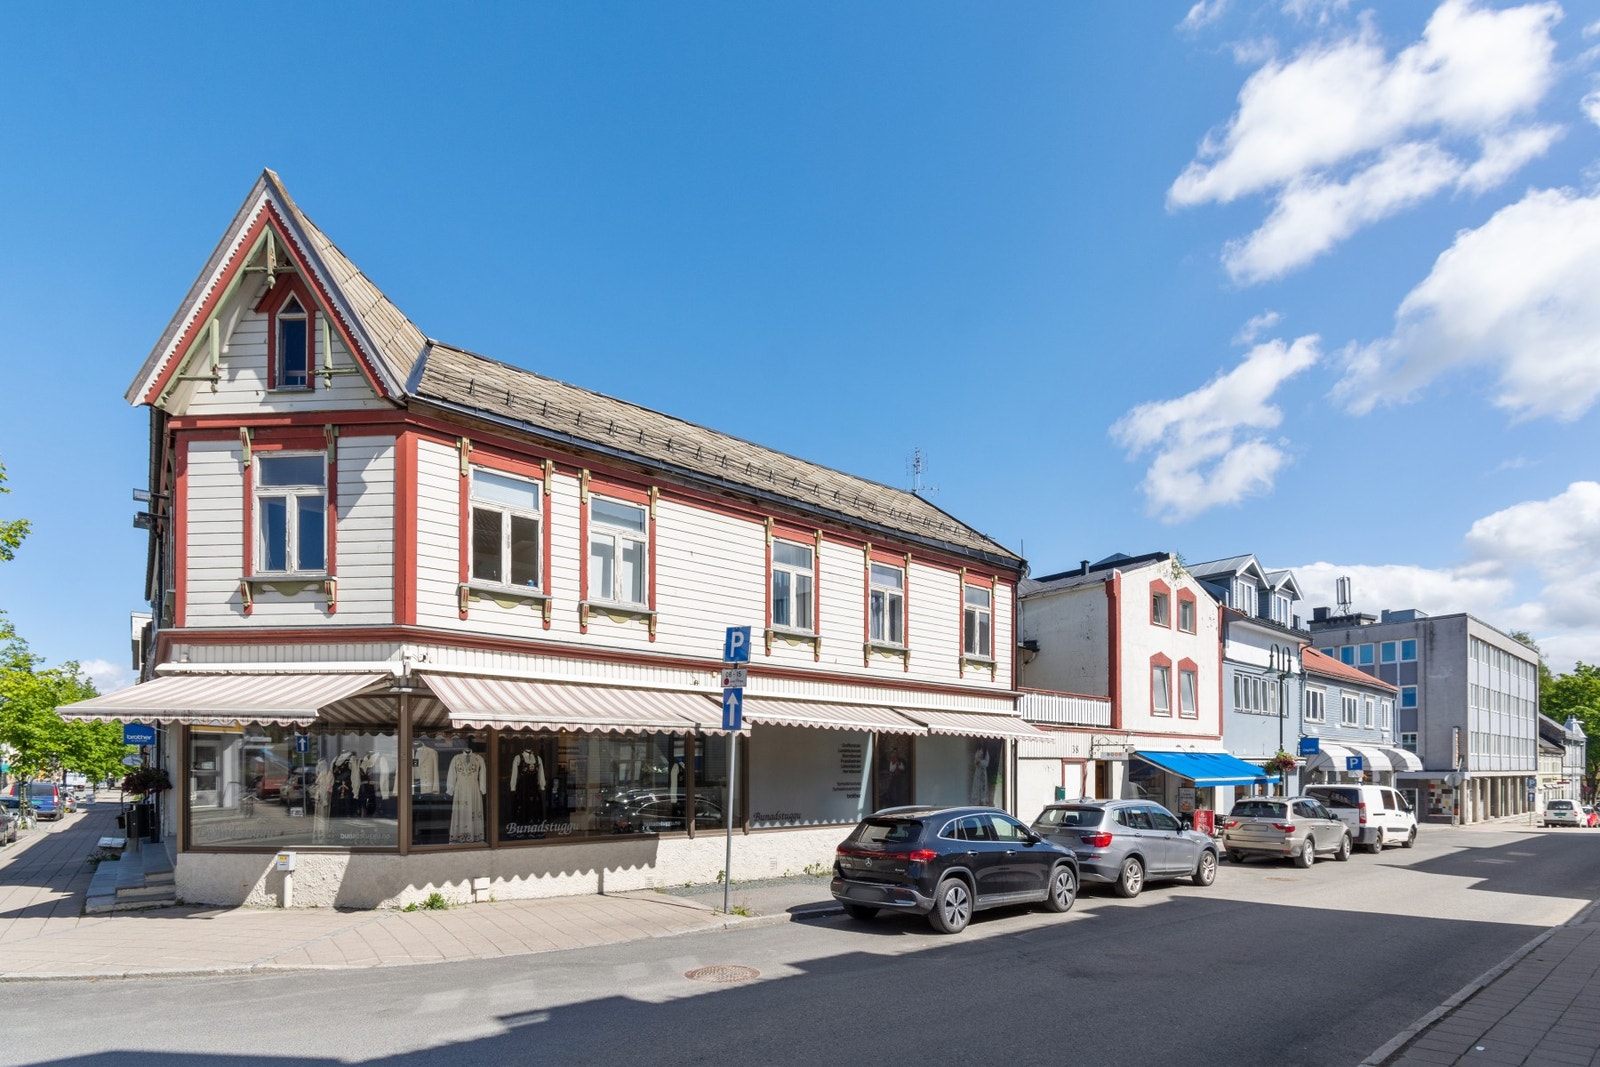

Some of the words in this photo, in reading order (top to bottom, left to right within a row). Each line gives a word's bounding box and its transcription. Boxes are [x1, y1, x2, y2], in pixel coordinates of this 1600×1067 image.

[730, 631, 745, 657] P
[1350, 757, 1358, 768] P
[753, 811, 801, 822] Bunadstuggu
[505, 820, 580, 835] Bunadstuggu
